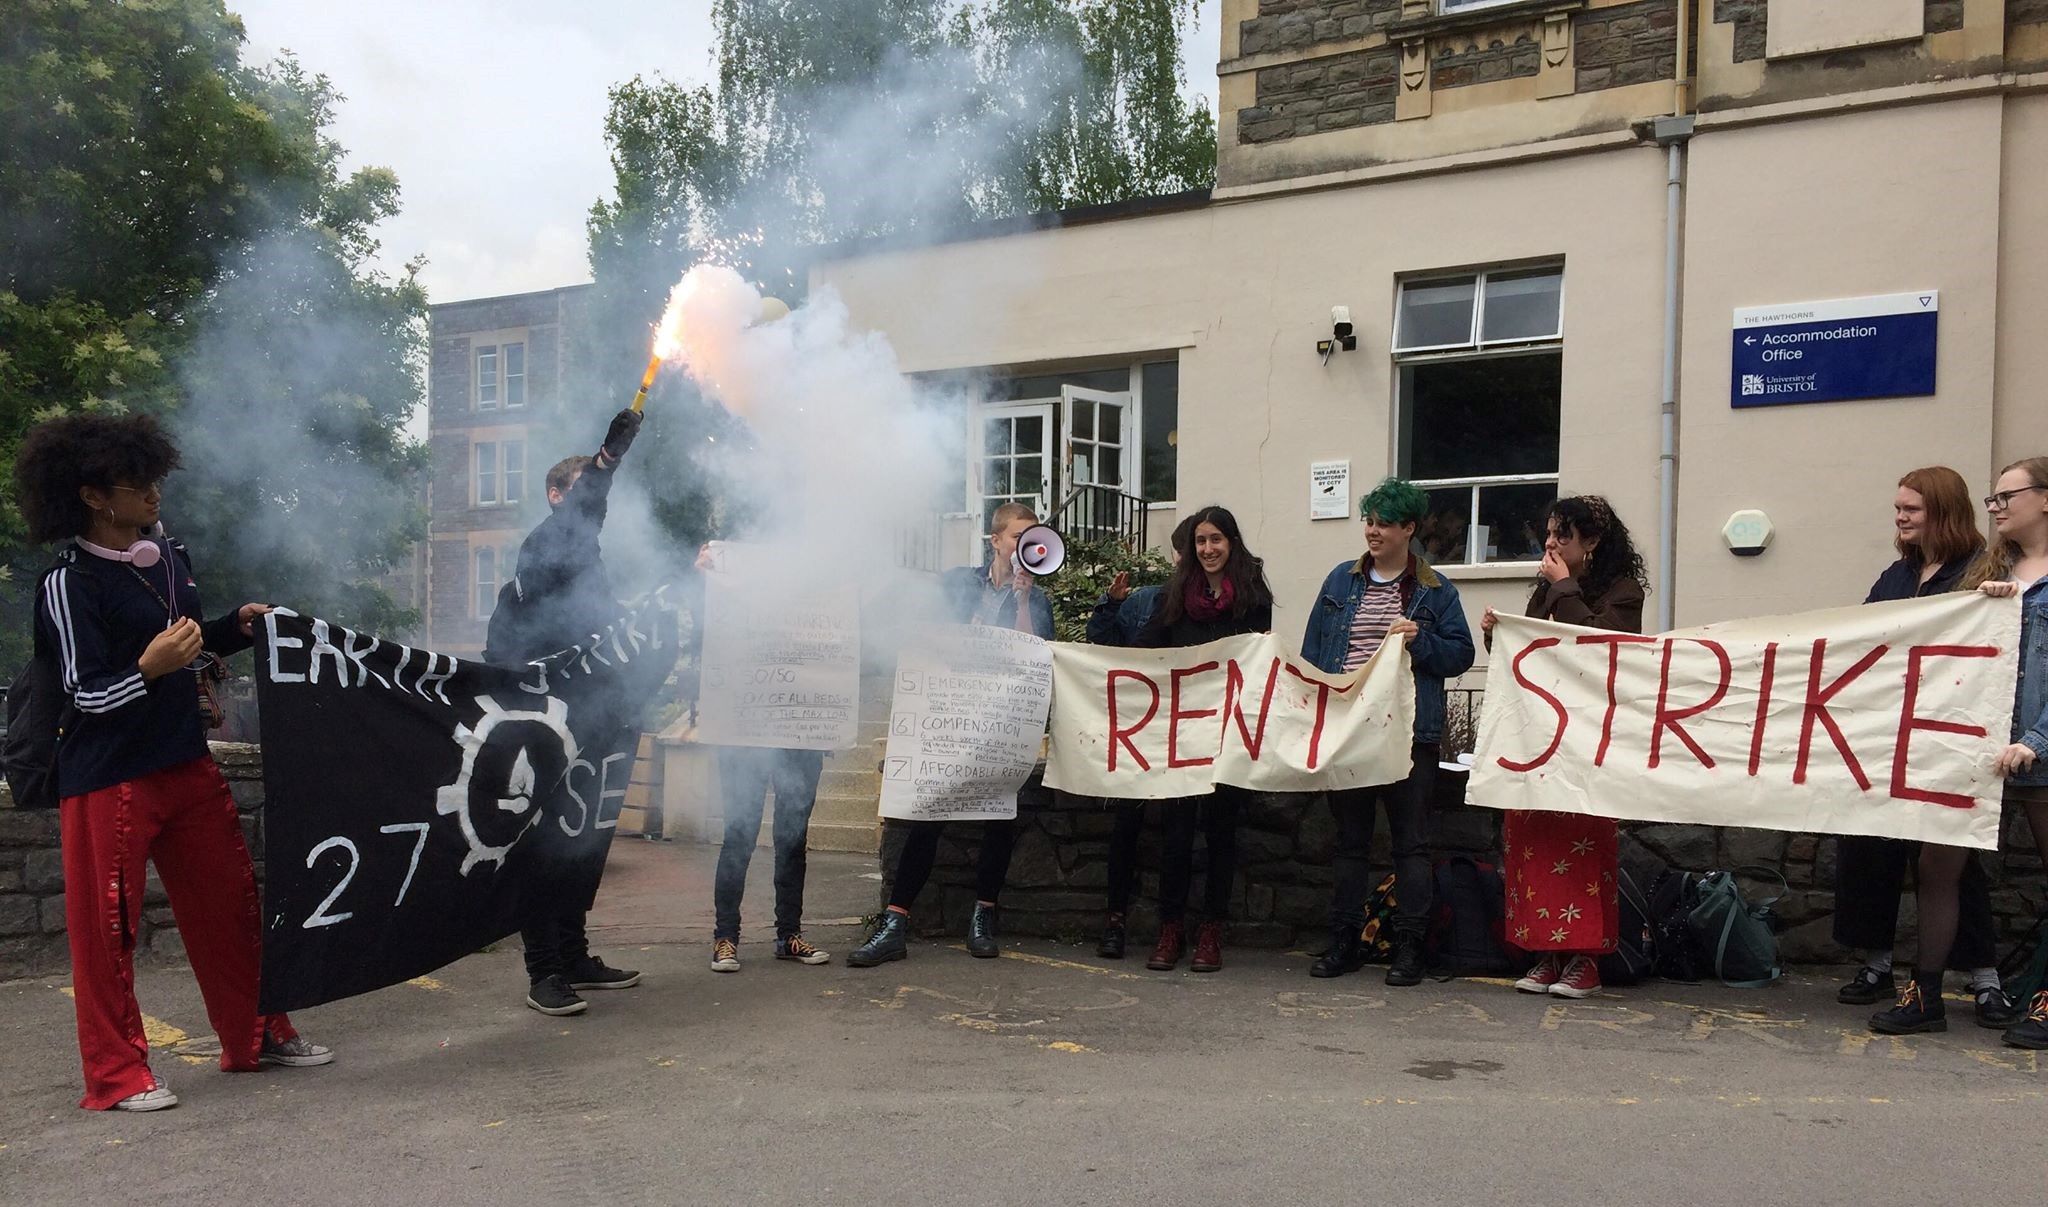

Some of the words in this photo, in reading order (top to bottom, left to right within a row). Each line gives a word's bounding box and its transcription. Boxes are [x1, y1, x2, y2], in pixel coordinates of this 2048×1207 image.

[1744, 316, 1760, 324] THE
[1762, 311, 1814, 322] HAWTHORNS
[1762, 325, 1877, 345] Accommodation
[1762, 349, 1803, 362] Office
[1766, 374, 1806, 385] University
[1807, 373, 1817, 382] of
[1766, 382, 1818, 394] BRISTOL
[264, 605, 458, 706] EARTH
[901, 672, 916, 691] 5
[928, 677, 1001, 693] EMERGENCY
[1007, 684, 1046, 698] HOUSING
[789, 692, 807, 705] ALL
[1107, 656, 1356, 773] RENT
[1496, 633, 2002, 809] STRIKE
[895, 718, 908, 734] 6
[921, 716, 1021, 738] COMPENSATION
[891, 759, 907, 778] 7
[919, 760, 996, 778] AFFORDABLE
[1001, 766, 1027, 778] RENT
[303, 822, 430, 929] 27
